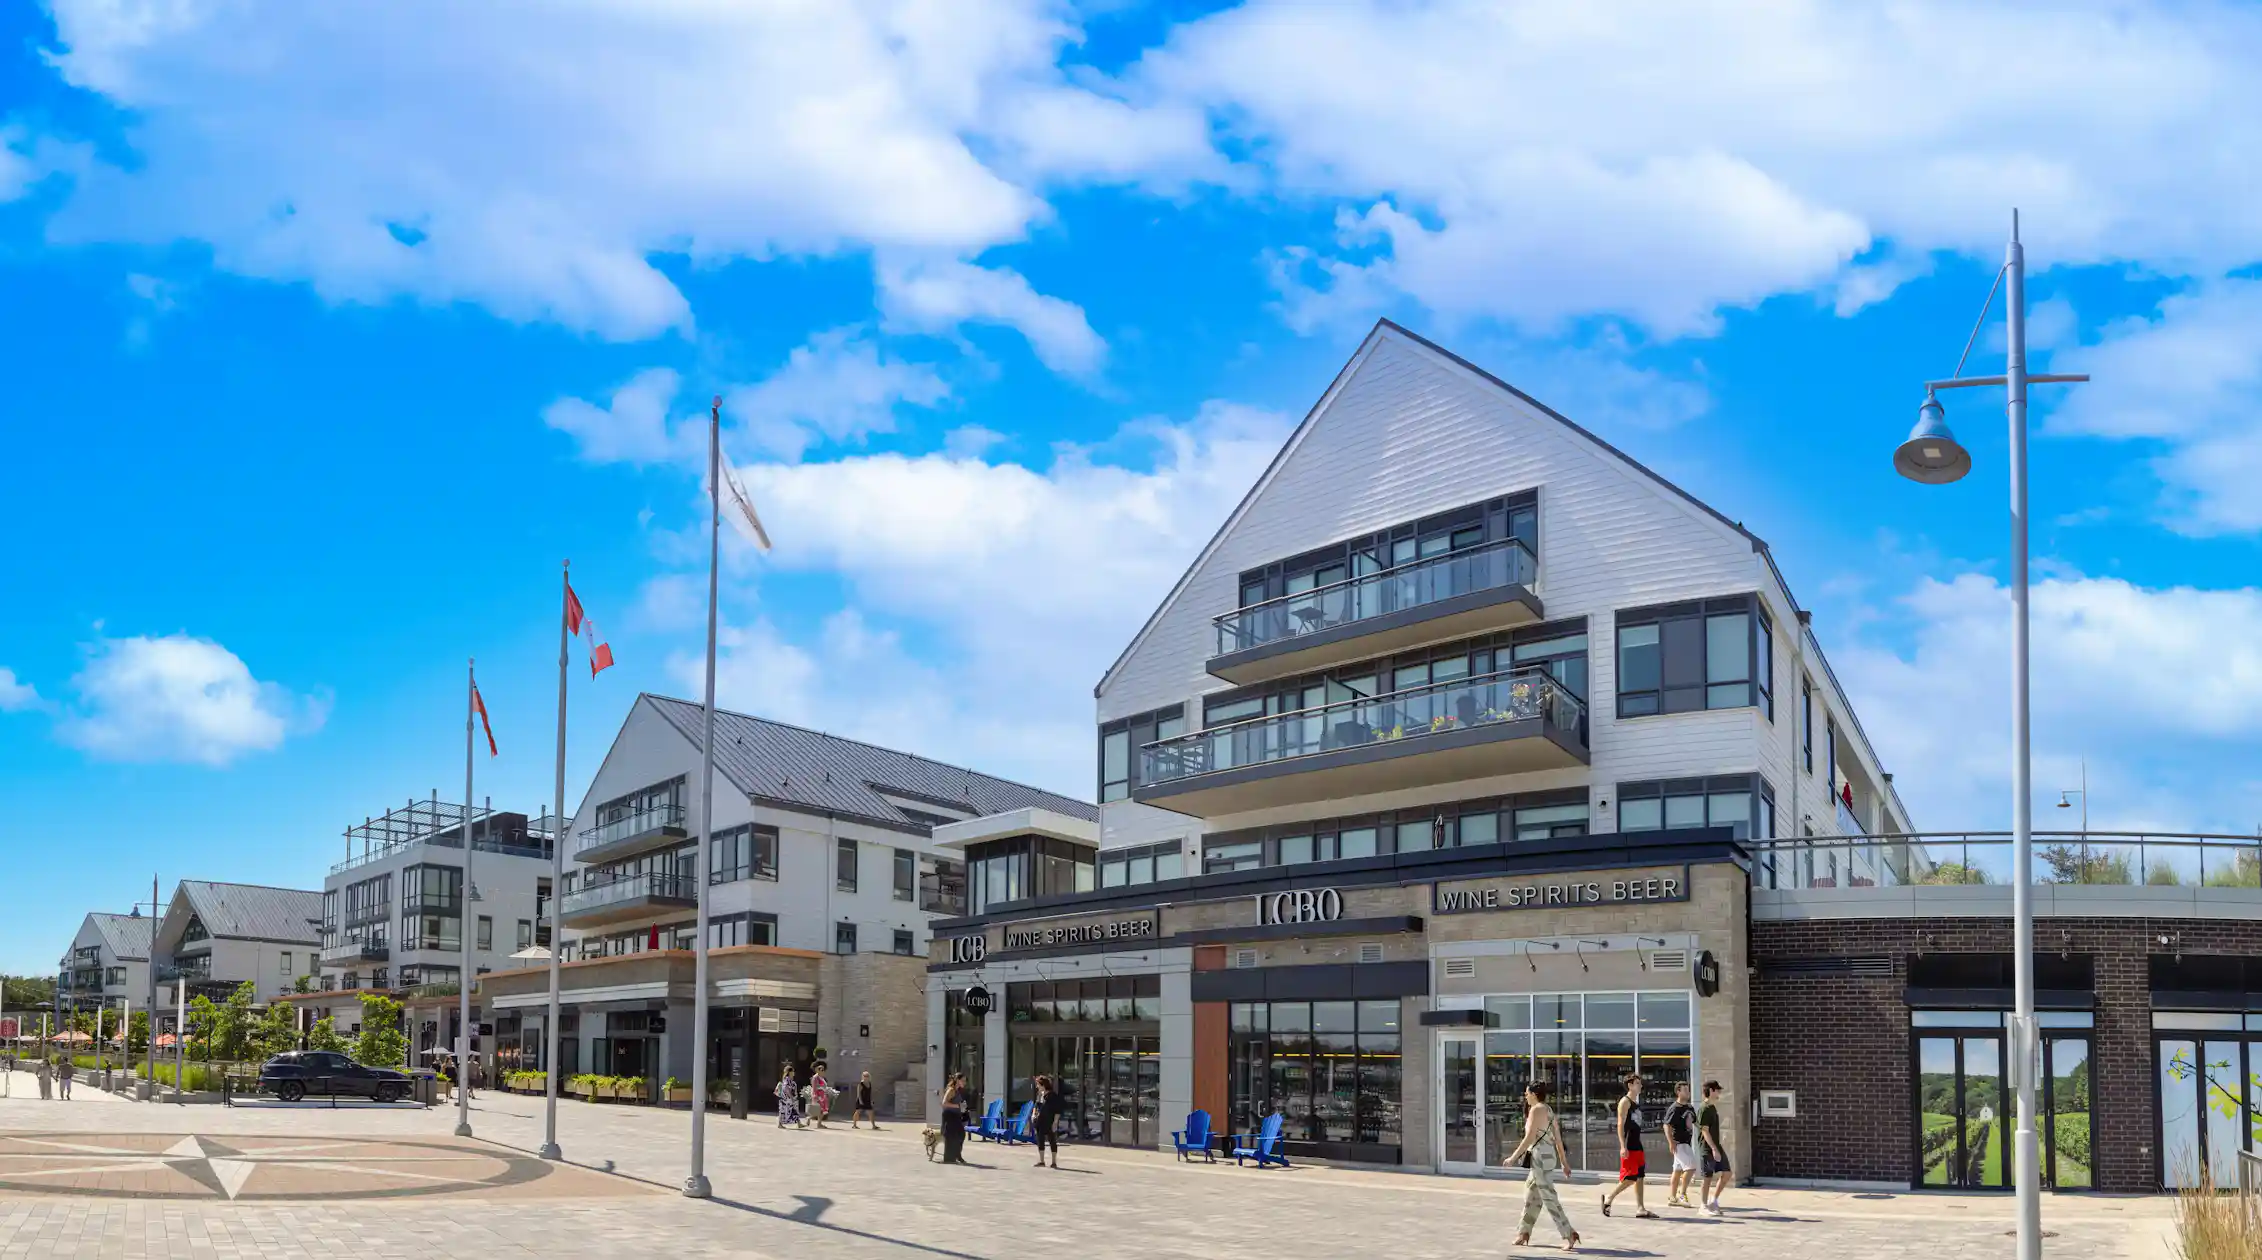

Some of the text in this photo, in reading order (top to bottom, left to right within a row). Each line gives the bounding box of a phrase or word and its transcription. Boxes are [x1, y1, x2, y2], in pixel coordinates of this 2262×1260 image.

[1255, 888, 1342, 926] LCBO
[1442, 879, 1678, 910] WINE SPIRITS BEER
[1007, 919, 1151, 947] WINE SPIRITS BEER
[967, 996, 989, 1007] LCBO
